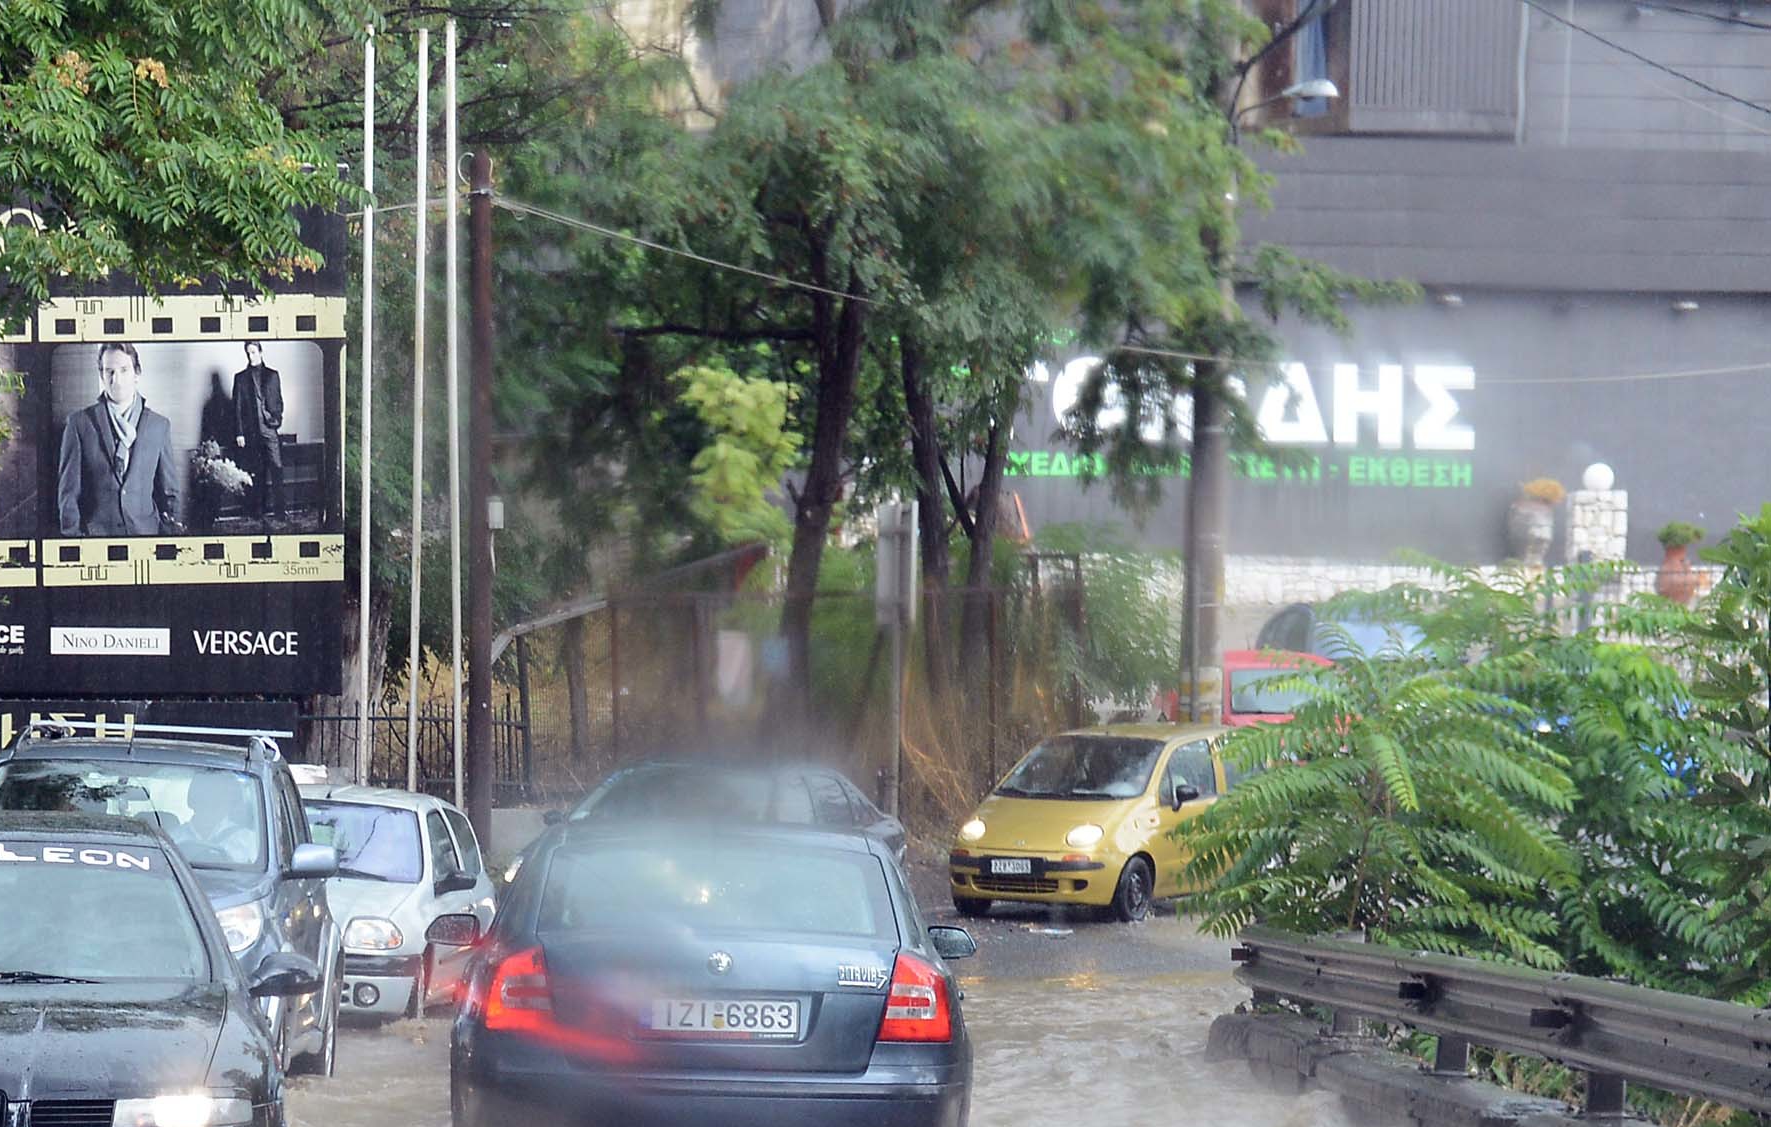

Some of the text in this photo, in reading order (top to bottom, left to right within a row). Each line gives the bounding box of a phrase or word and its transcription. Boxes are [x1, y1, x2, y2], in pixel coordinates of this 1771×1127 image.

[1348, 455, 1474, 488] ΕΚΘΕΣΗ
[283, 564, 320, 576] 35mm
[193, 629, 299, 656] VERSACE
